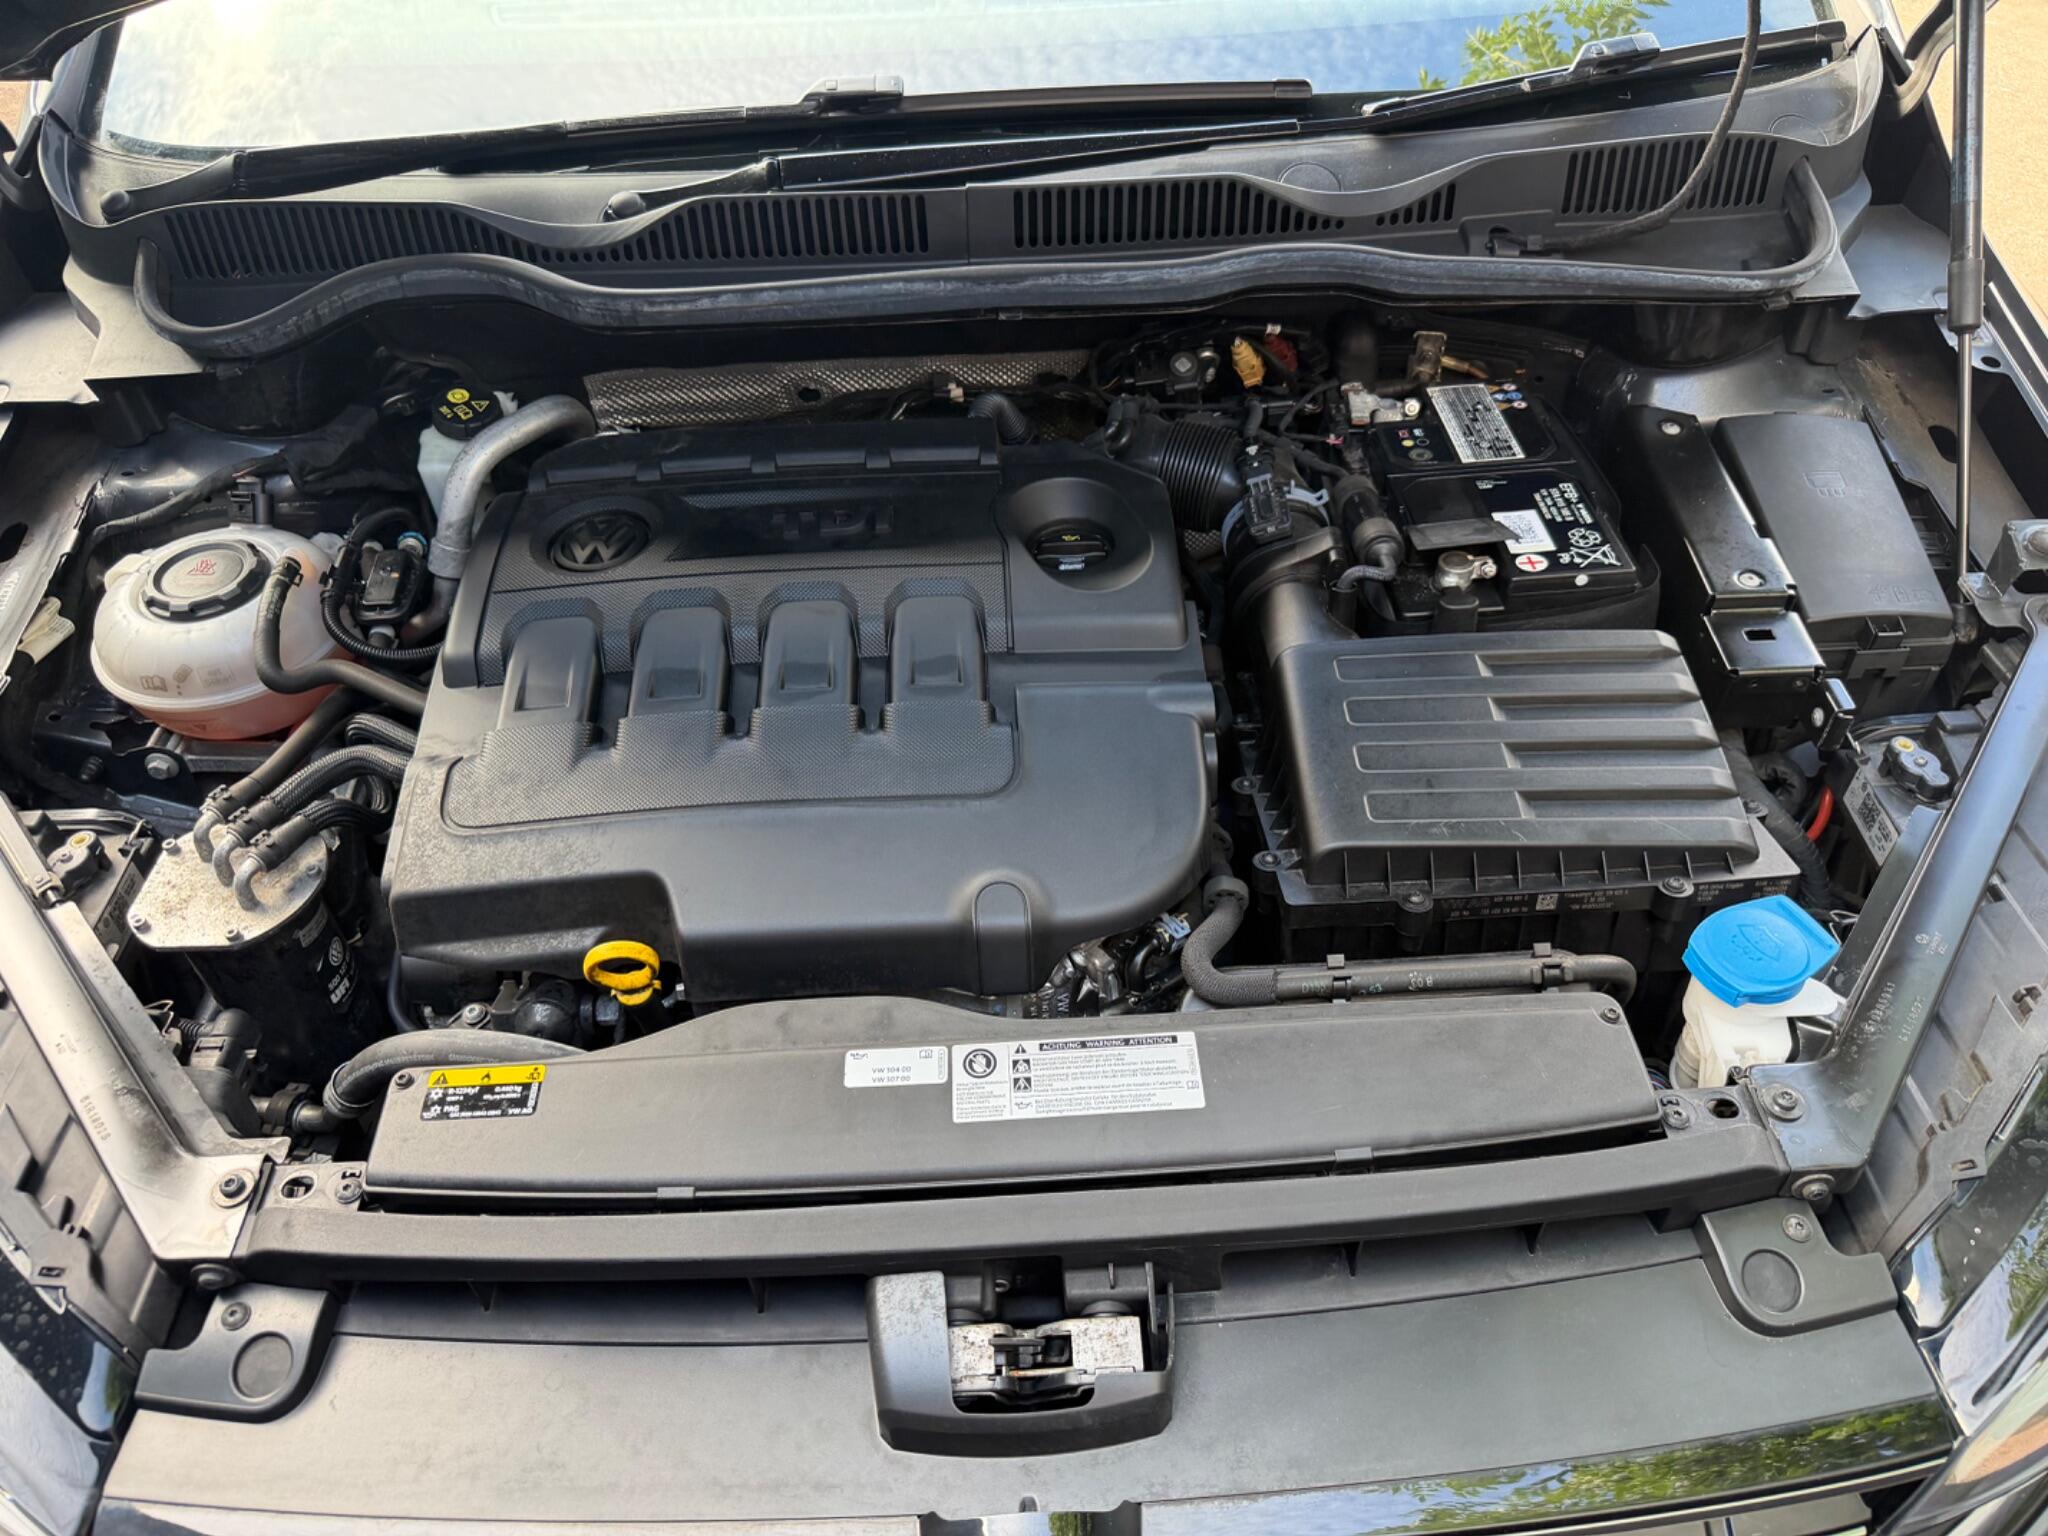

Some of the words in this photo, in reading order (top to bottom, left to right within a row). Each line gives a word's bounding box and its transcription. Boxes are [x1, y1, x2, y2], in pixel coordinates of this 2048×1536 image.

[1041, 1042, 1081, 1051] ACHTUNG
[1085, 1039, 1127, 1049] WARNING
[1128, 1036, 1173, 1046] ATTENTION
